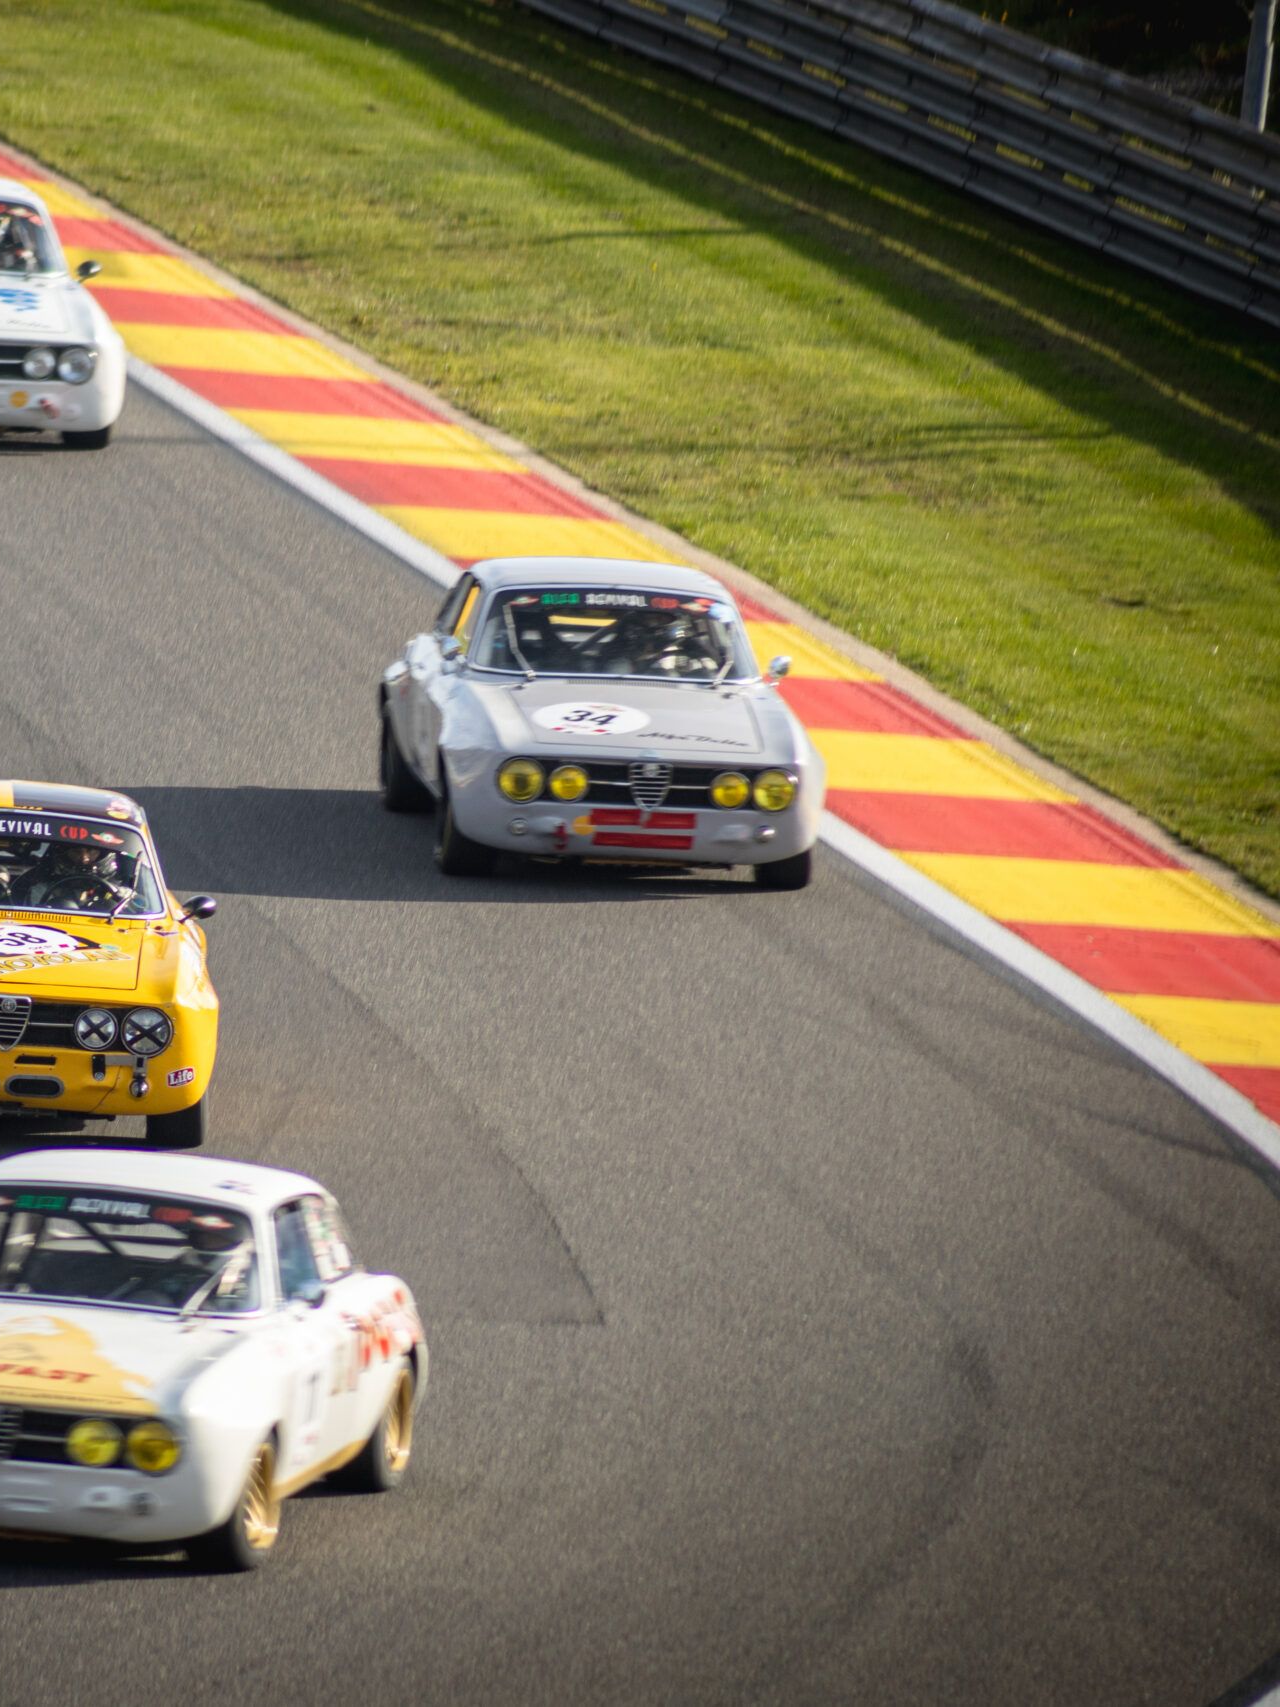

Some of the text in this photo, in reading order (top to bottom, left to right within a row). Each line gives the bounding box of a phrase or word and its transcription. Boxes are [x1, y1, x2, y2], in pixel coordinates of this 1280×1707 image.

[563, 710, 617, 726] 34
[59, 825, 89, 840] CUP
[170, 1069, 193, 1085] Life
